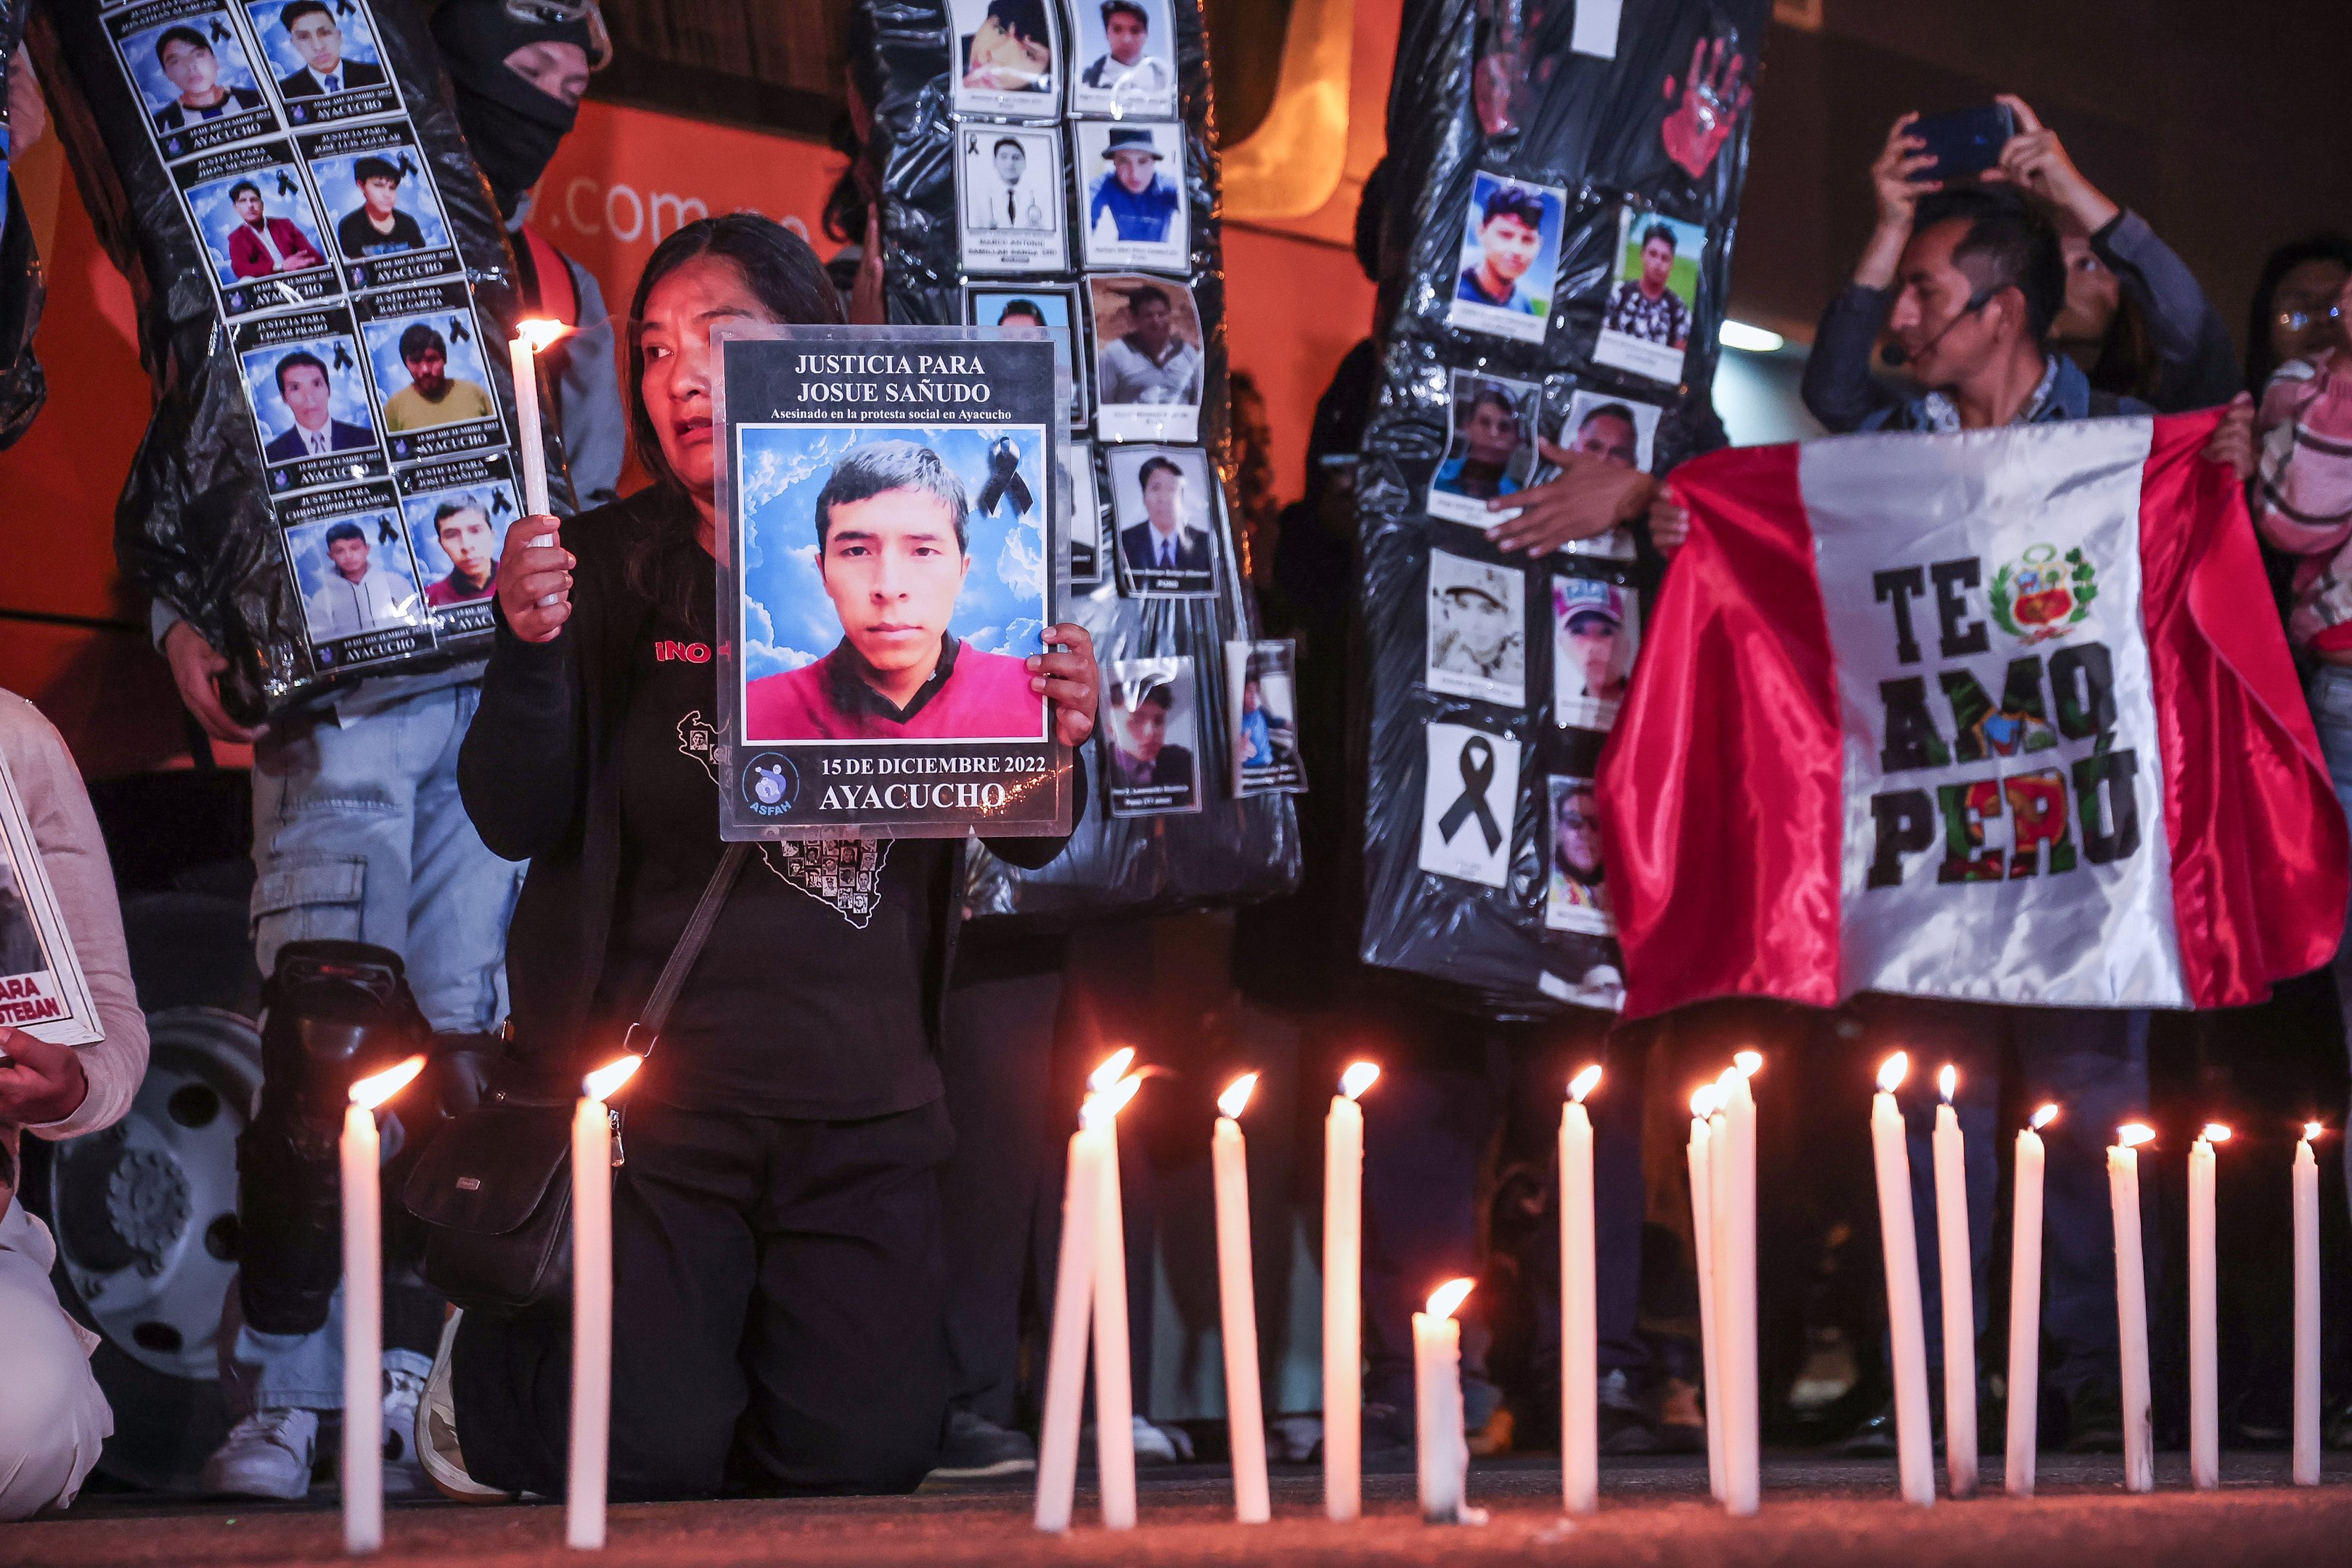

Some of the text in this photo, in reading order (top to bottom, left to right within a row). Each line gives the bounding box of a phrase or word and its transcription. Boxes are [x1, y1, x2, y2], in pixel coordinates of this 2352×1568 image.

[377, 88, 392, 97] 2022
[256, 110, 271, 121] 2022
[318, 99, 383, 121] AYACUCHO
[194, 123, 261, 149] AYACUCHO
[322, 126, 388, 142] JUSTICIA PARA
[197, 147, 266, 169] JUSTICIA PARA
[439, 250, 454, 259] 2022
[319, 270, 334, 280] 2022
[377, 262, 443, 283] AYACUCHO
[256, 283, 323, 305] AYACCHO
[375, 287, 443, 304] JUSTICIA PARA
[256, 314, 326, 332] JUSTICIA PARA
[260, 328, 293, 341] EDGAR
[295, 323, 328, 335] PRADO
[795, 354, 985, 375] JUSTICIA PARA
[797, 378, 991, 403] JOSUE SAÑUDO
[483, 420, 499, 430] 2022
[771, 408, 828, 420] Asesinado
[846, 408, 858, 420] la
[860, 409, 906, 422] protesta
[908, 409, 940, 420] social
[958, 409, 1012, 422] Ayacucho
[417, 433, 488, 454] AYACUCHO
[366, 452, 381, 460] 2022
[301, 463, 369, 484] AYACUCO
[415, 460, 484, 478] JUSTICIA PARA
[301, 486, 370, 506] JUSTICIA PARA
[285, 499, 354, 522] CHRISTOPHER
[356, 494, 390, 507] RAMOS
[1873, 557, 1990, 665] TE
[346, 637, 416, 663] AYACUCHO
[1879, 642, 2118, 773] AMO
[822, 756, 1046, 775] 15 DE DICIEMBRE 2022
[819, 782, 1005, 811] AYACUCHO
[750, 801, 792, 816] ASFAH
[1866, 727, 2142, 891] PERÚ
